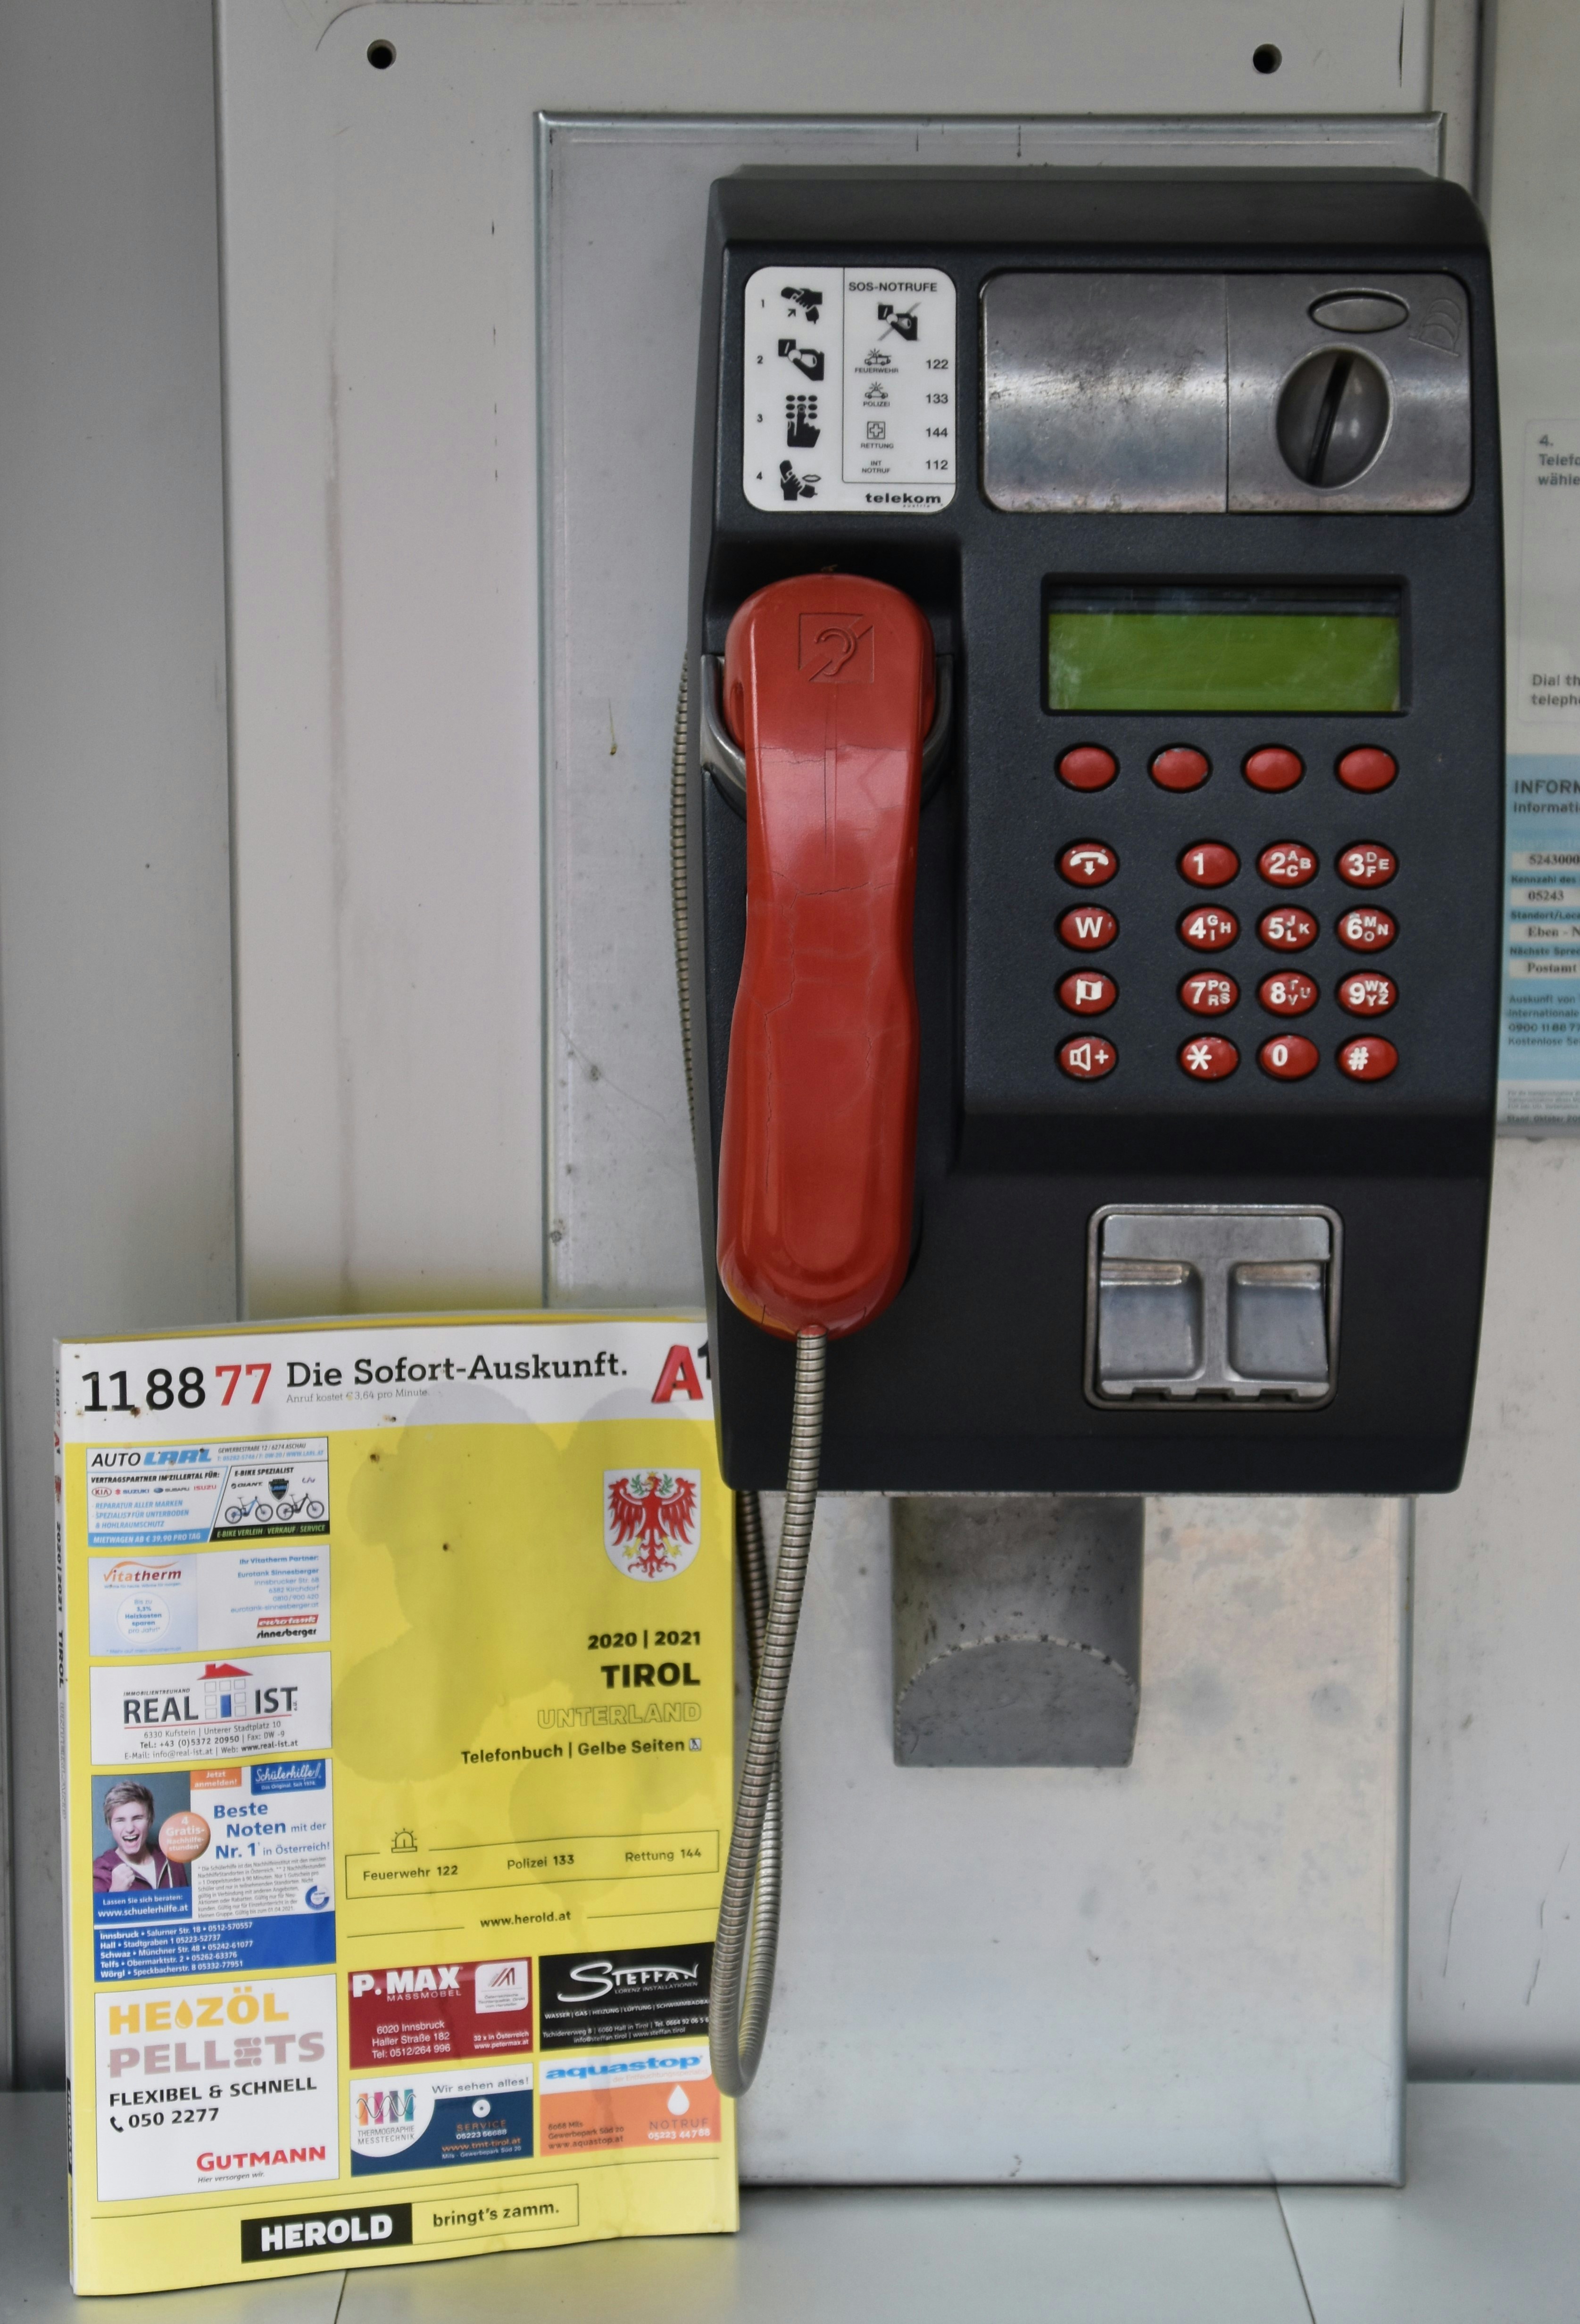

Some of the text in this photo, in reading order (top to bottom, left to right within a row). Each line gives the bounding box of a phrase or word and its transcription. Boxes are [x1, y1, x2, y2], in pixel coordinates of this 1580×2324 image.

[849, 283, 937, 292] SOS-NOTRUFE
[926, 359, 948, 369] 122
[925, 394, 948, 404] 133
[757, 414, 763, 422] 3
[925, 428, 948, 437] 144
[1539, 434, 1554, 446] 4.
[925, 460, 948, 470] 112
[865, 493, 941, 503] telekom
[1532, 674, 1560, 686] Dial
[1511, 875, 1556, 883] Kennzahl
[1528, 890, 1564, 901] 05243
[1076, 917, 1103, 938] W
[1528, 926, 1559, 937] Eben
[1528, 962, 1577, 973] Postamt
[1509, 1023, 1538, 1032] 0900
[1553, 1023, 1566, 1032] 88
[1273, 1045, 1287, 1066] 0
[287, 1351, 627, 1388] Die Sofort-Auskunft.
[81, 1371, 136, 1412] 11
[145, 1366, 206, 1410] 88
[215, 1363, 272, 1406] 77
[91, 1453, 141, 1467] AUTO
[169, 1472, 203, 1481] ZILLERTAL
[217, 1524, 325, 1538] E-BIKE VERLEIH VERKAUF SERVICE
[104, 1570, 181, 1582] vitatherm
[588, 1631, 700, 1650] 2020 2021
[601, 1663, 700, 1689] TIROL
[255, 1687, 298, 1714] IST
[124, 1696, 199, 1724] REAL
[538, 1702, 701, 1729] UNTERLAND
[234, 1722, 270, 1732] Stadtplatz
[153, 1740, 298, 1759] info@real-ist.at www.real-ist.at
[461, 1739, 684, 1765] Telefonbuch Gelbe Seiten
[194, 1780, 237, 1788] anmelden!
[214, 1803, 268, 1819] Beste
[227, 1822, 326, 1838] Noten mit der
[216, 1842, 330, 1859] Nr. Österreich!
[363, 1849, 701, 1881] Feuerwehr 122 Polizei 133 Rettung 144
[98, 1905, 188, 1917] www.schuelerhilfe.at
[480, 1911, 571, 1928] www.herold.at
[100, 1922, 252, 1940] Innsbruck 0512-570557
[124, 1939, 168, 1948] Stadtgraben
[176, 1934, 221, 1944] 05223-52737
[127, 1958, 177, 1966] Obermarktstr.
[133, 1965, 189, 1976] Speckbacherstr.
[642, 1982, 698, 1991] INSTALLATIONEN
[387, 1989, 461, 2002] MASSMÖBEL
[377, 2021, 444, 2034] 6020 Innsbruck
[543, 2029, 586, 2039] Tschidererweg
[372, 2032, 449, 2046] Haller Straße 182
[574, 2027, 685, 2043] info@steffan.tirol www.steffan.tirol
[390, 2044, 450, 2057] 0512/264 996
[474, 2040, 528, 2049] www.petermax.at
[109, 2032, 325, 2078] PELLETS
[546, 2056, 701, 2079] aquastop
[109, 2077, 316, 2107] FLEXIBEL SCHNELL
[432, 2077, 528, 2094] Wir sehen alles!
[128, 2107, 219, 2128] 050 2277
[649, 2118, 708, 2129] NOTRUF
[358, 2125, 415, 2137] THERMOGRAPHIE
[457, 2119, 506, 2131] SERVICE
[358, 2134, 415, 2145] MESSTECHNIK
[649, 2131, 676, 2140] 05223
[549, 2136, 624, 2149] www.aquastop.at
[196, 2146, 325, 2172] GUTMANN
[215, 2173, 249, 2182] versorgen
[260, 2214, 392, 2252] HEROLD
[503, 2201, 559, 2218] zamm.
